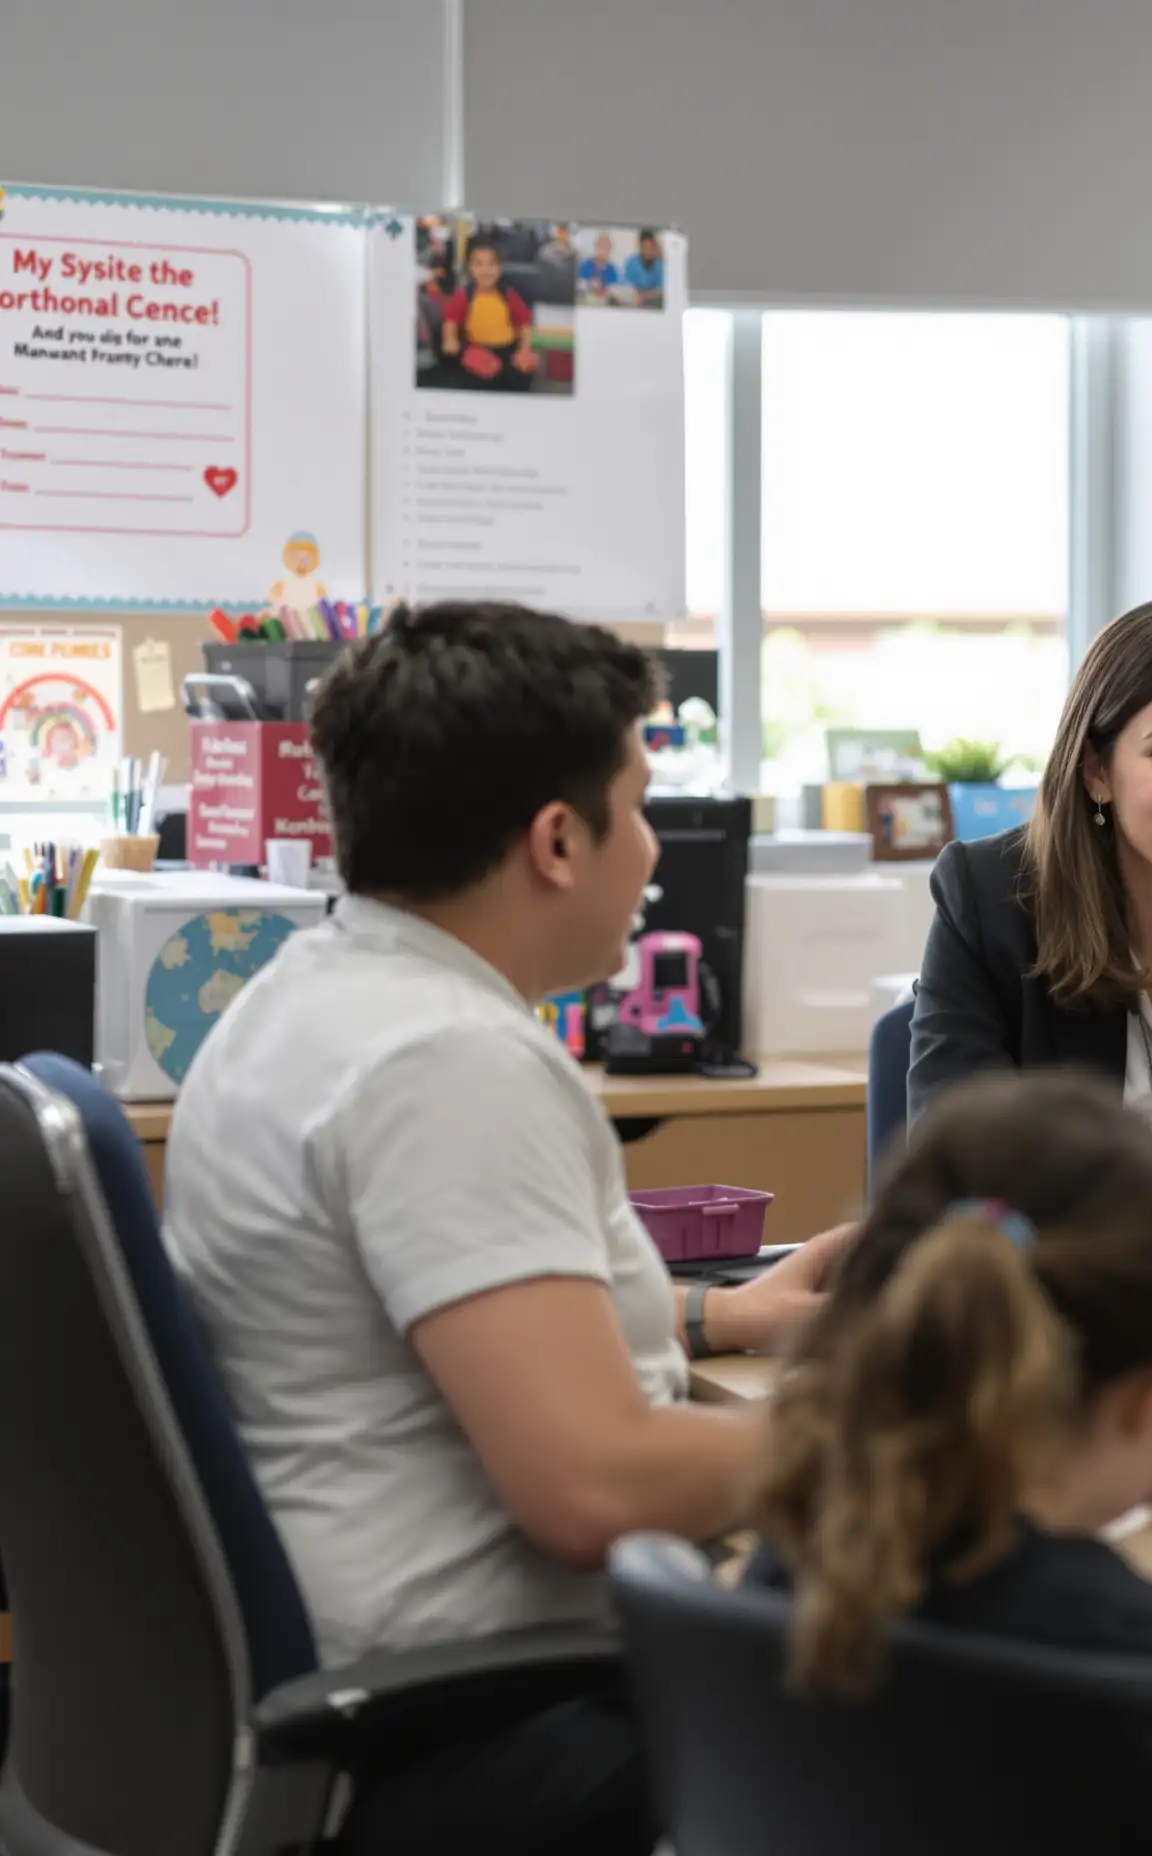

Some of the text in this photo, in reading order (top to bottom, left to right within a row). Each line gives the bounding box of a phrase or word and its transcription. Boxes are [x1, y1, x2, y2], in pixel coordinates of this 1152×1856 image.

[13, 248, 194, 287] My Sysite the
[126, 294, 219, 326] Cence!
[32, 325, 64, 341] And
[68, 330, 95, 345] you
[126, 329, 149, 346] for
